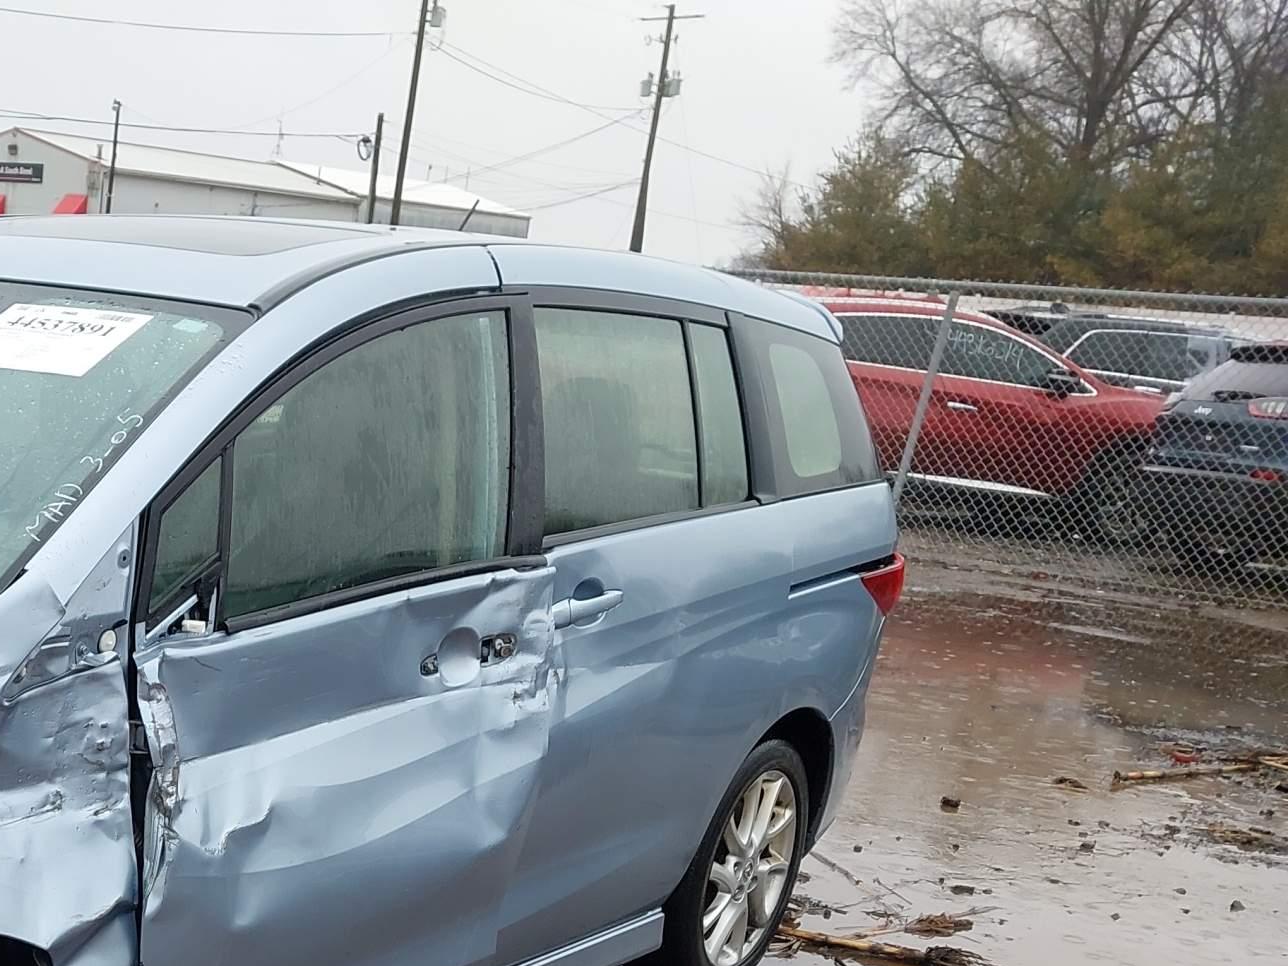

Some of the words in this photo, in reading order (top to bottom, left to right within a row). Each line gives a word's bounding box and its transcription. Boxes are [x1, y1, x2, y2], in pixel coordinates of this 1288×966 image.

[8, 315, 117, 337] 44537891
[25, 483, 83, 542] MAD
[80, 408, 144, 473] 3-05
